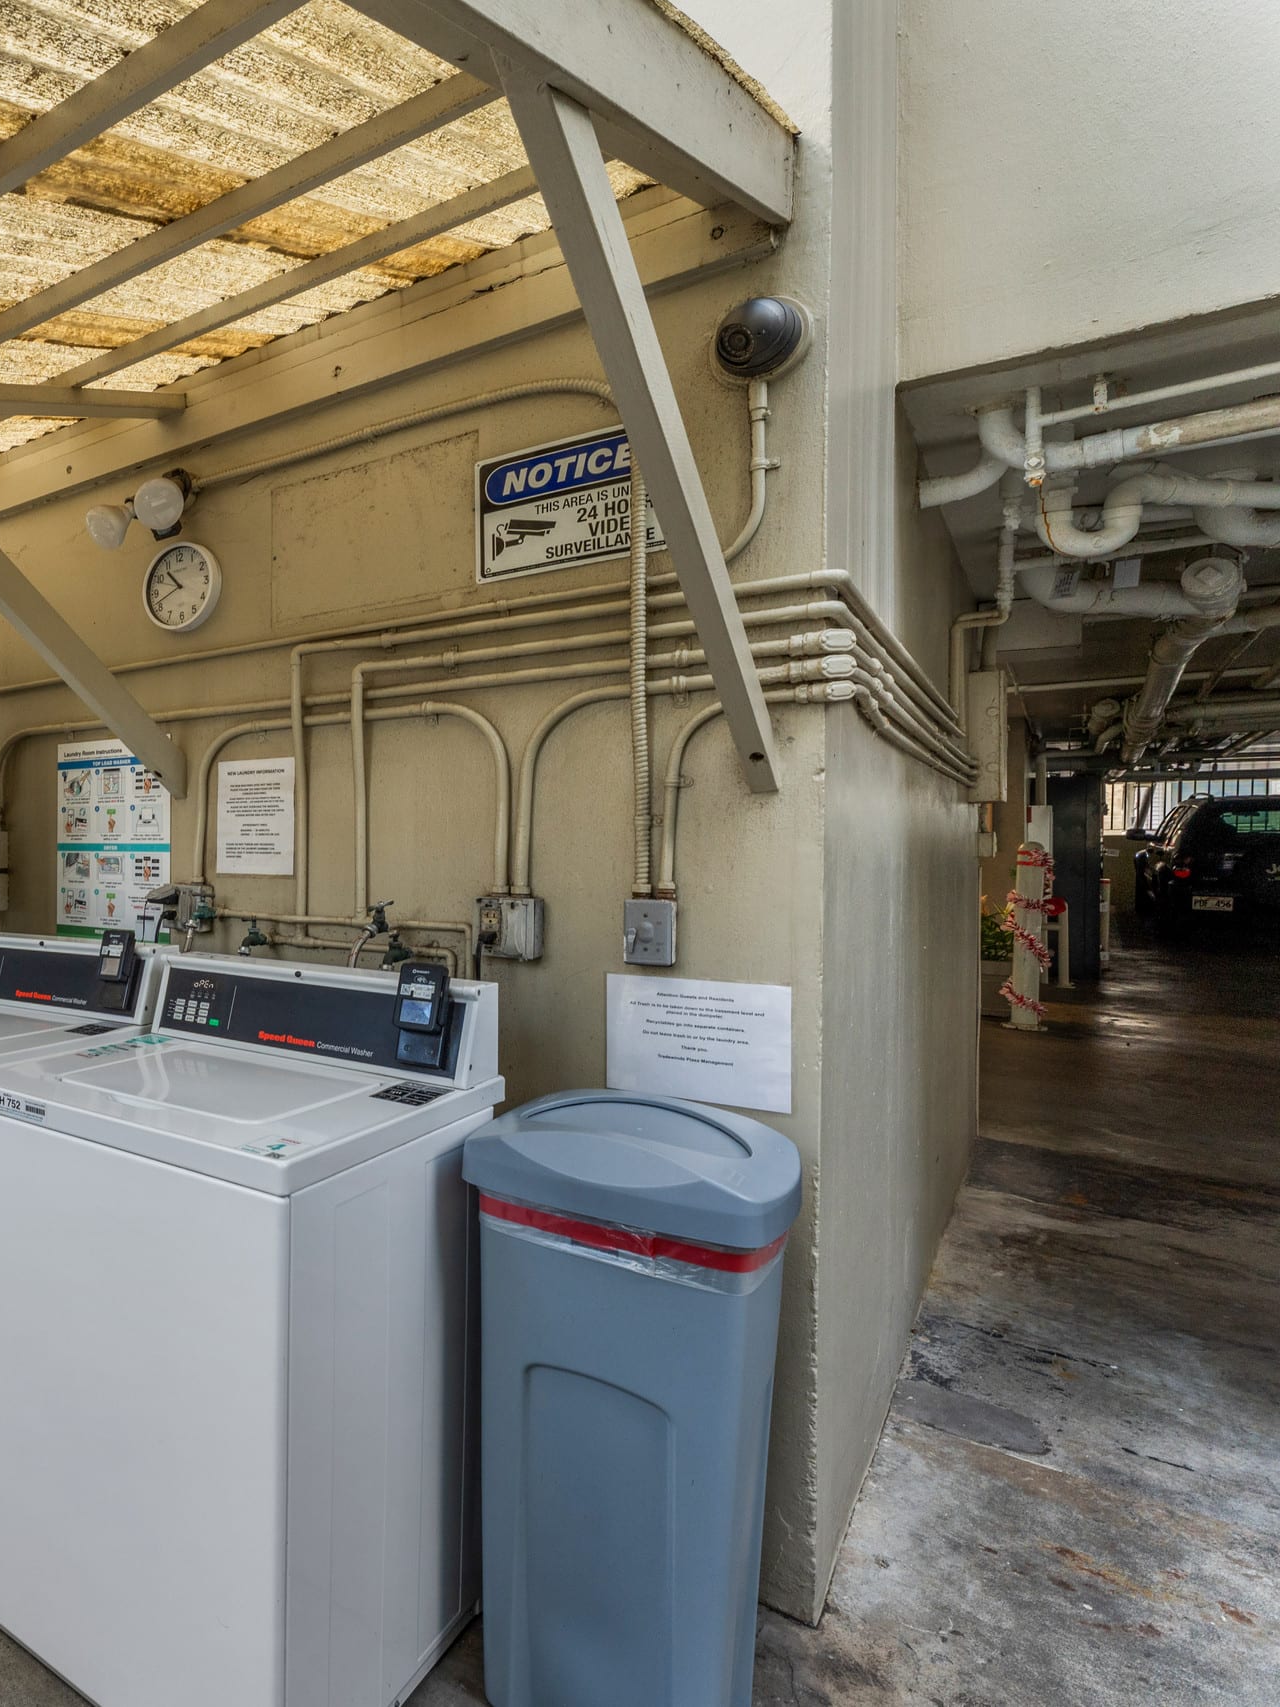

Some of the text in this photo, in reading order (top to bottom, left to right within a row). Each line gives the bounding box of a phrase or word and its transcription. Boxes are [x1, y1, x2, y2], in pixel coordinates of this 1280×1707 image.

[502, 442, 631, 496] NOTICE
[535, 499, 560, 515] THIS
[562, 493, 594, 510] AREA
[597, 489, 608, 502] IS
[576, 507, 599, 523] 24
[588, 515, 631, 537] VIDE
[63, 750, 81, 758] Laundry
[15, 989, 34, 998] Speed
[258, 1030, 374, 1058] Speed Queen Commercial Washer
[6, 1098, 21, 1110] 752
